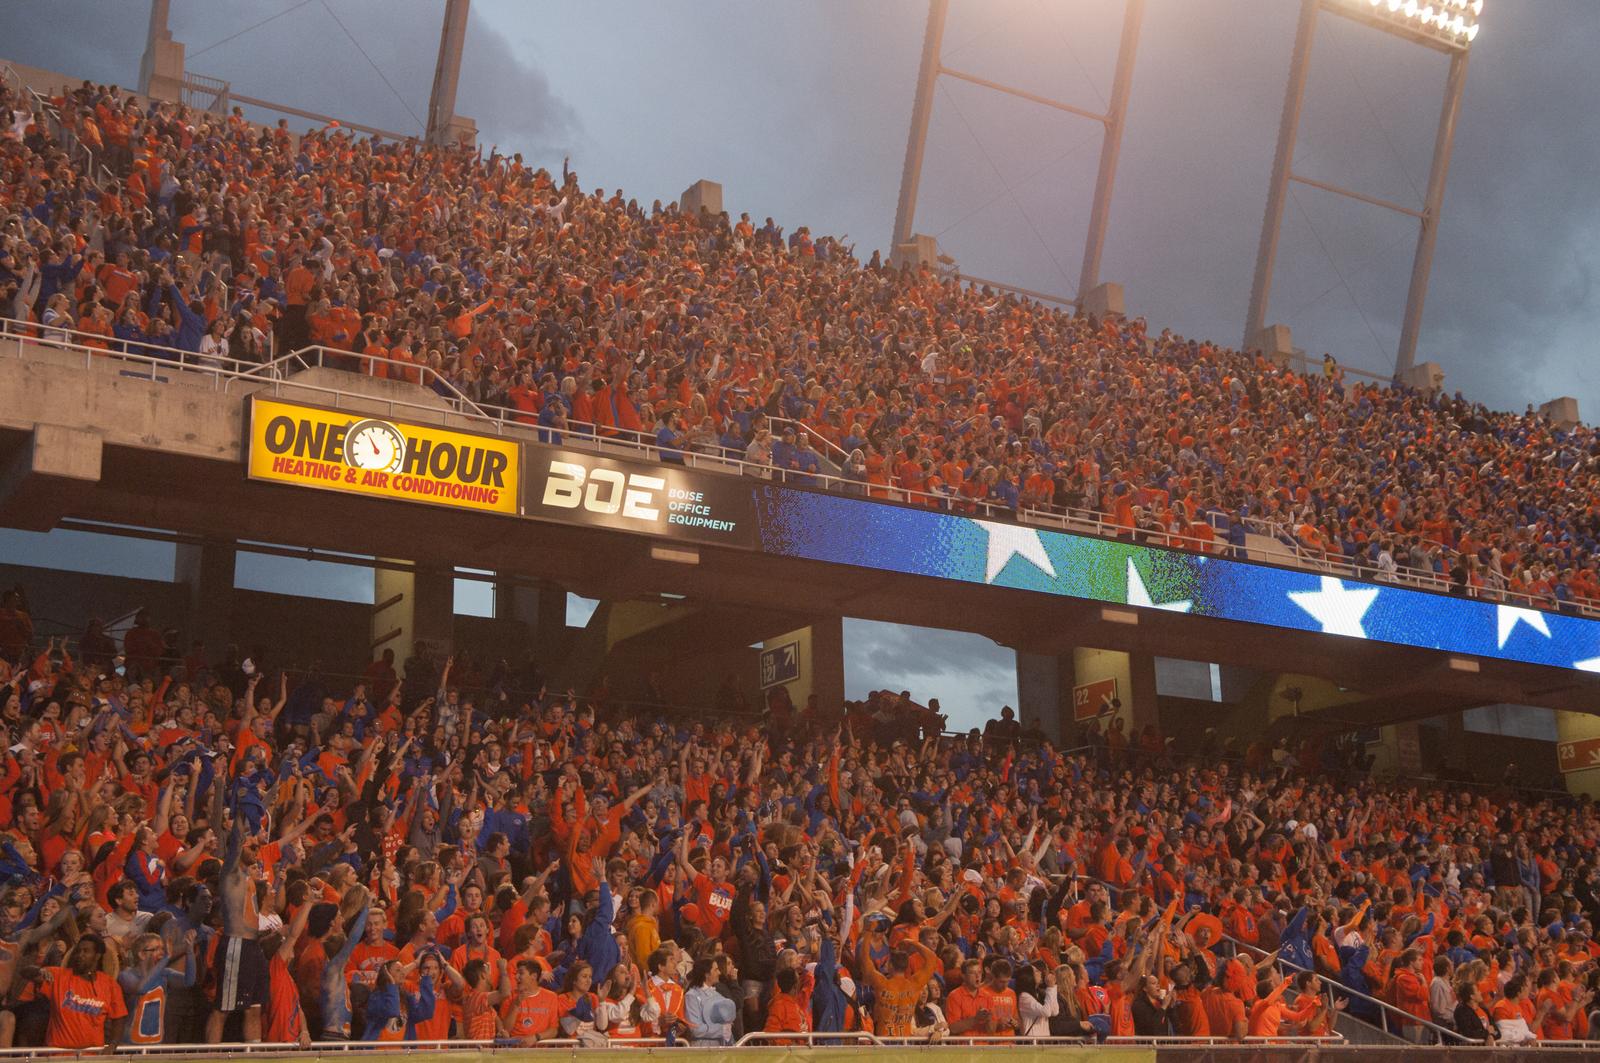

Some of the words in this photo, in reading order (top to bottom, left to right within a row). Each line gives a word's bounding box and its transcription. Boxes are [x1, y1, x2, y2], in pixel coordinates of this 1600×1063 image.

[264, 415, 345, 463] ONE
[402, 437, 508, 488] HOUR
[272, 456, 341, 482] HEATING
[344, 467, 357, 484] &
[361, 469, 388, 488] AIR
[392, 474, 499, 504] CONDITIONING
[542, 460, 665, 521] BOE
[668, 488, 704, 502] BOISE
[668, 501, 711, 516] OFFICE
[668, 514, 736, 532] EQUIPMENT
[763, 666, 775, 682] 121
[1077, 689, 1089, 705] 22
[1561, 746, 1575, 759] 23
